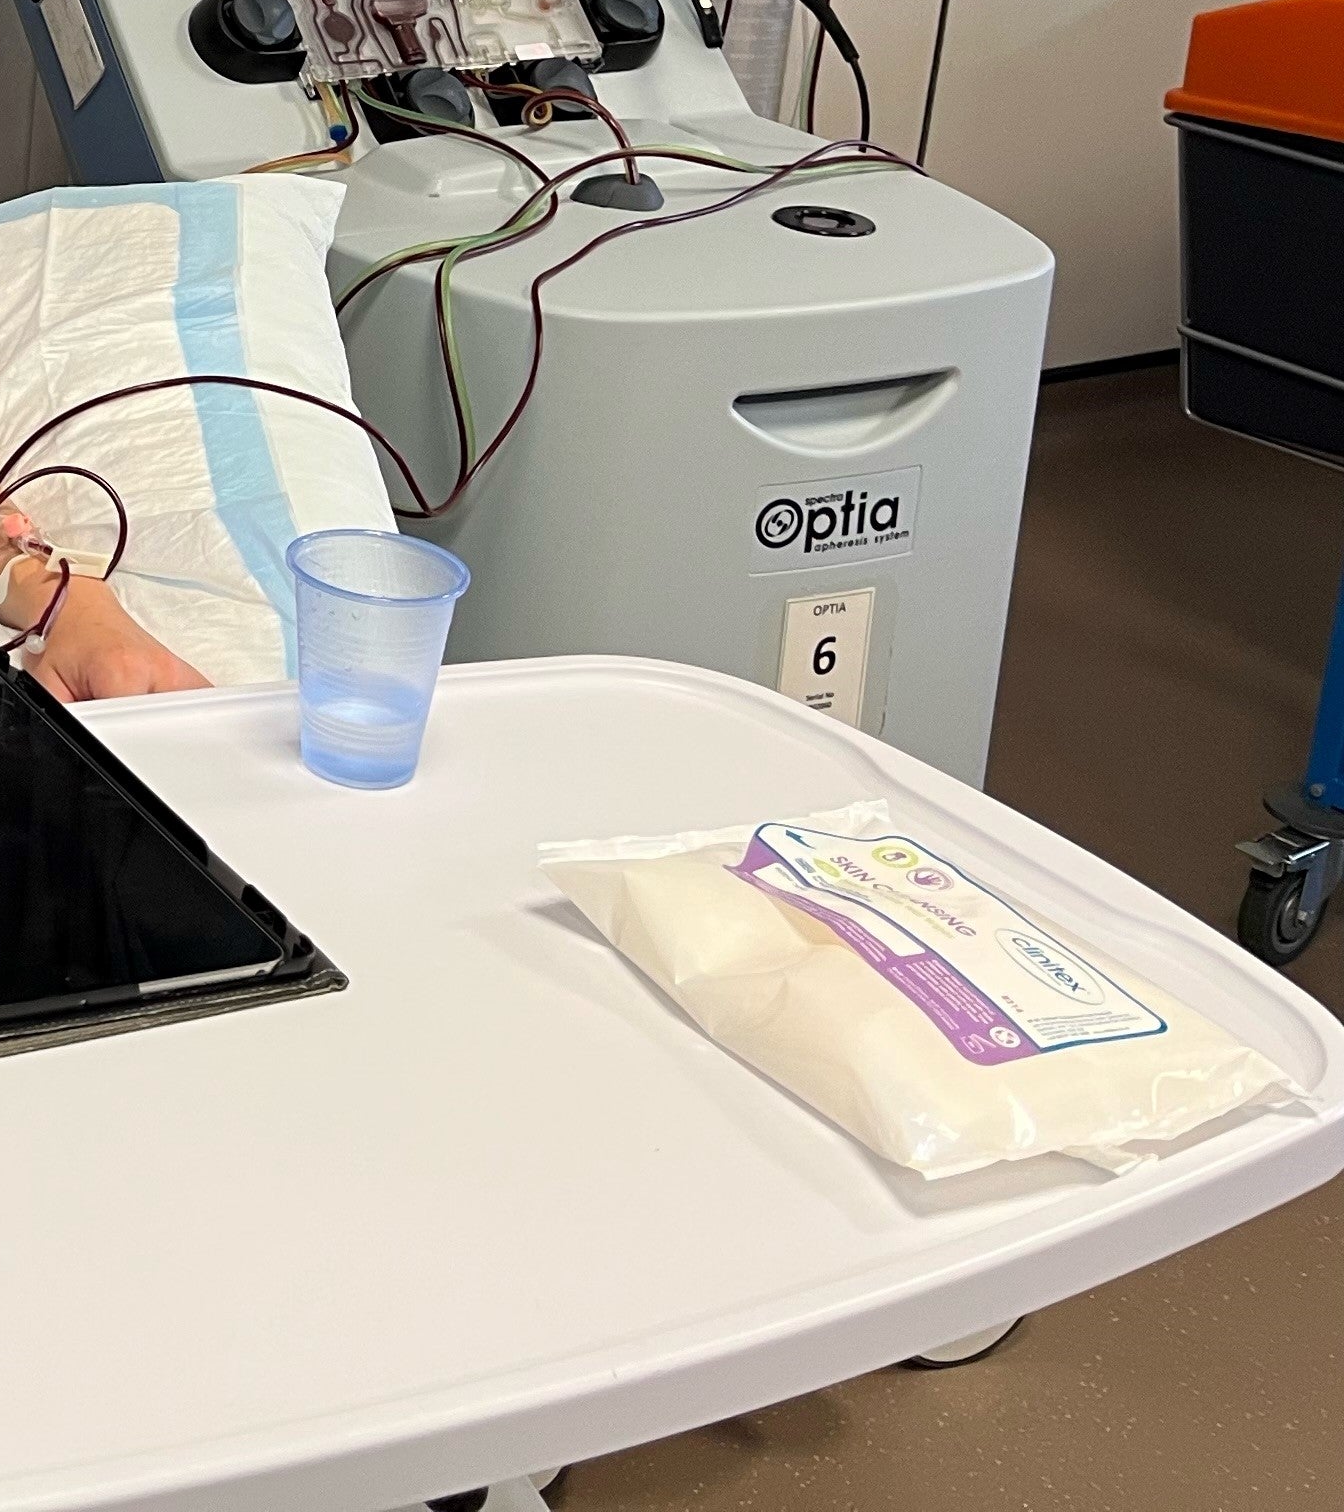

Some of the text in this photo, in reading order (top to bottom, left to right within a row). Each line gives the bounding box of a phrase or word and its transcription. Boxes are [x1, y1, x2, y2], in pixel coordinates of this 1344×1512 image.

[805, 492, 844, 506] spectra
[755, 490, 900, 553] Optia
[814, 530, 910, 553] apheresis system
[813, 602, 847, 617] OPTIA
[813, 636, 837, 676] 6
[829, 854, 875, 886] SKIN
[1011, 937, 1087, 992] clinitex
